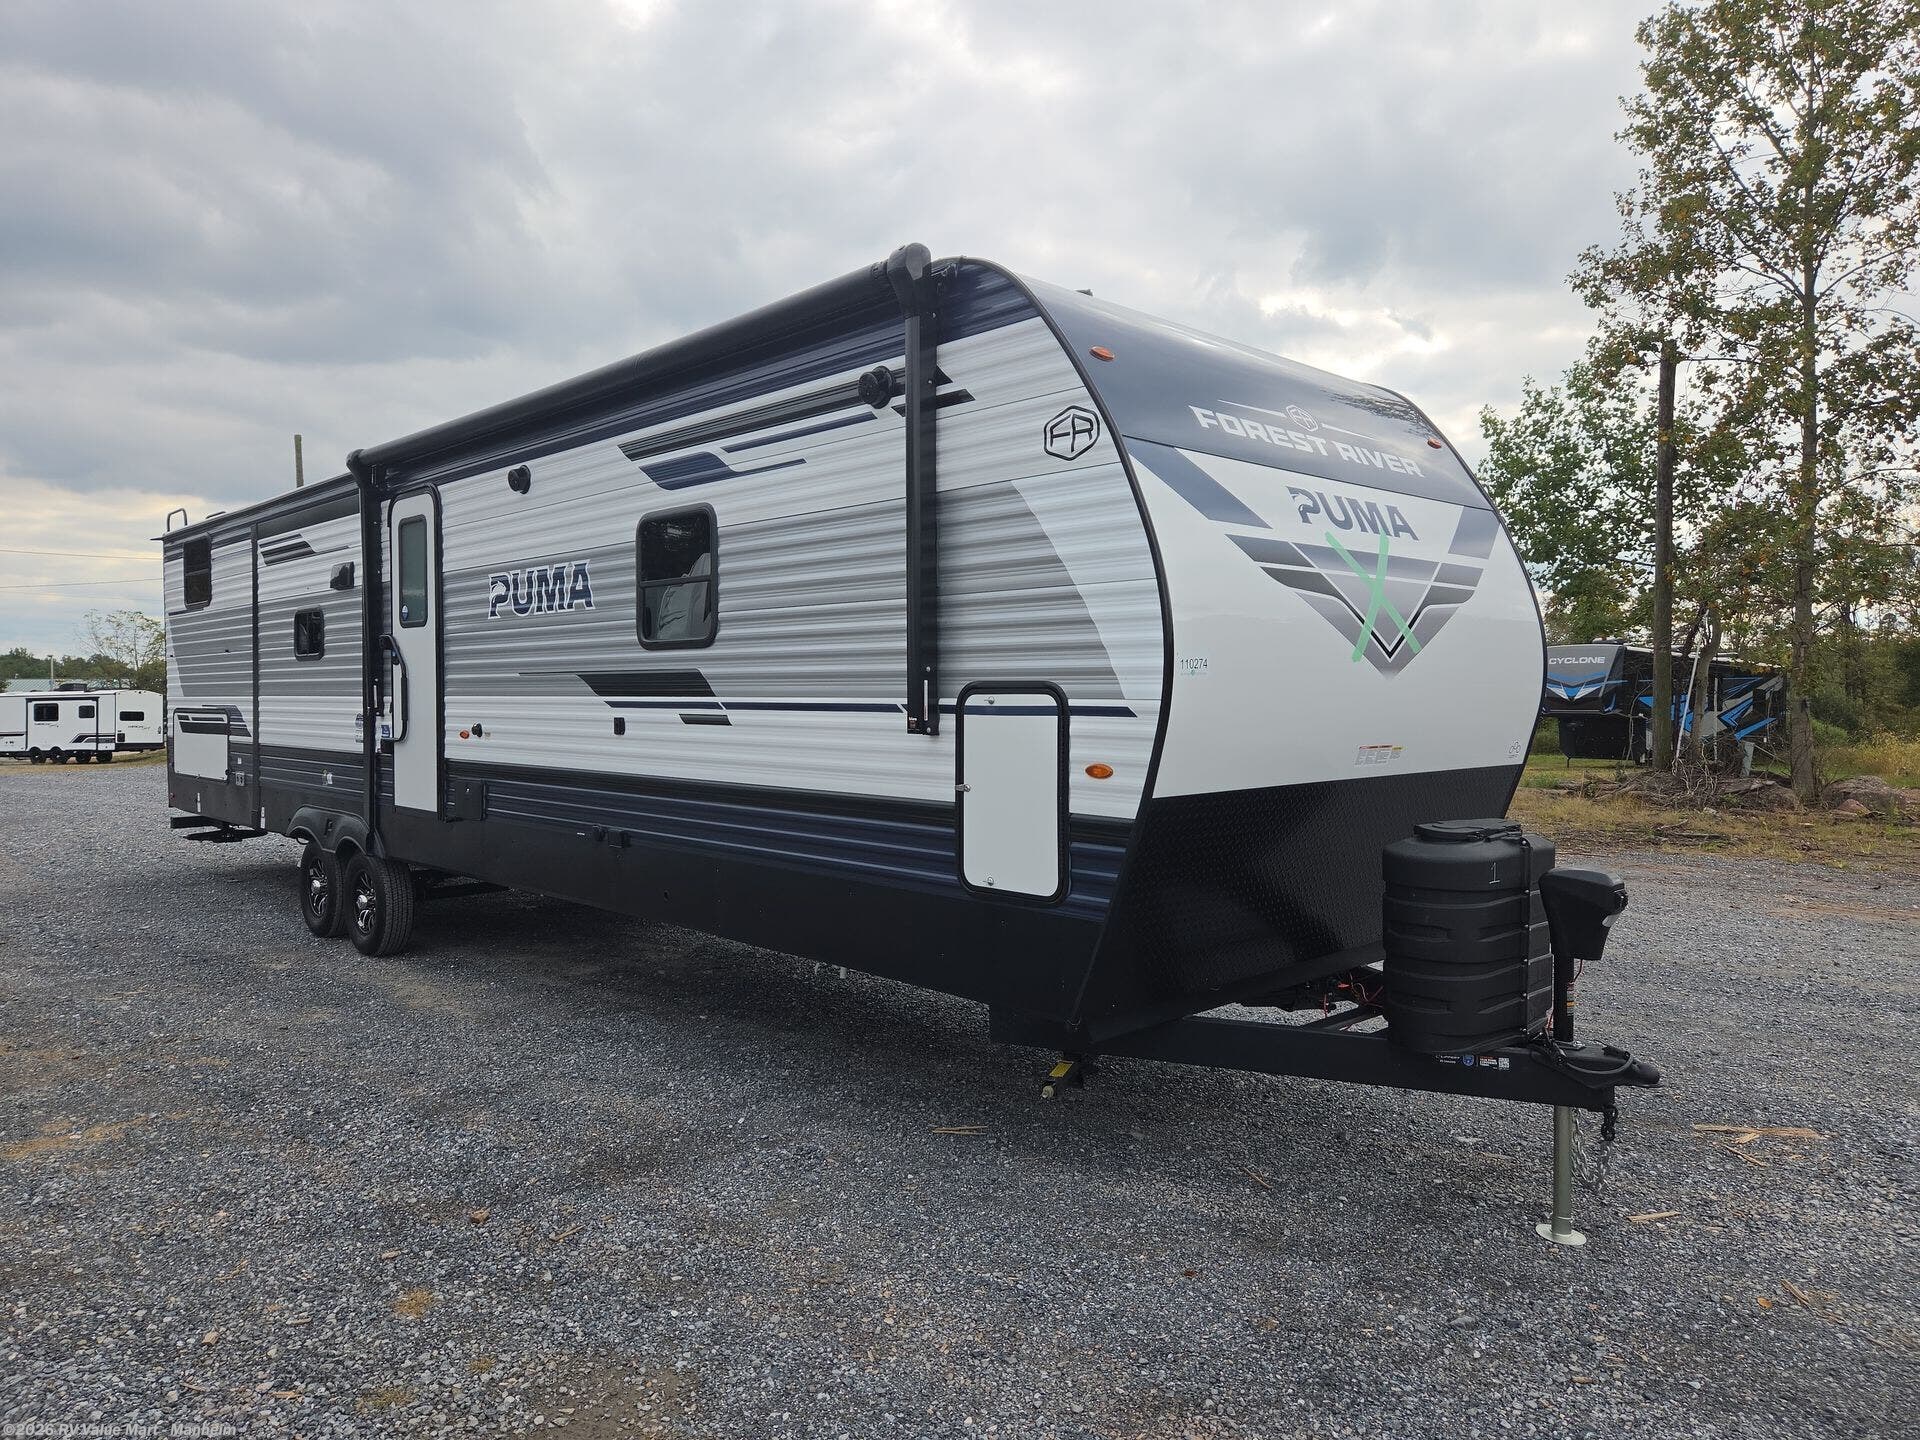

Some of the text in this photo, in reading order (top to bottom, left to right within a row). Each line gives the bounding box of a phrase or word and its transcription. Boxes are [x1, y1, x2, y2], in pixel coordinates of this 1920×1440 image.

[1188, 405, 1425, 478] FOREST RIVER
[1285, 485, 1420, 541] PUMA
[487, 560, 596, 620] PUMA
[1180, 658, 1208, 670] 110274
[1548, 656, 1606, 665] CYCLONE
